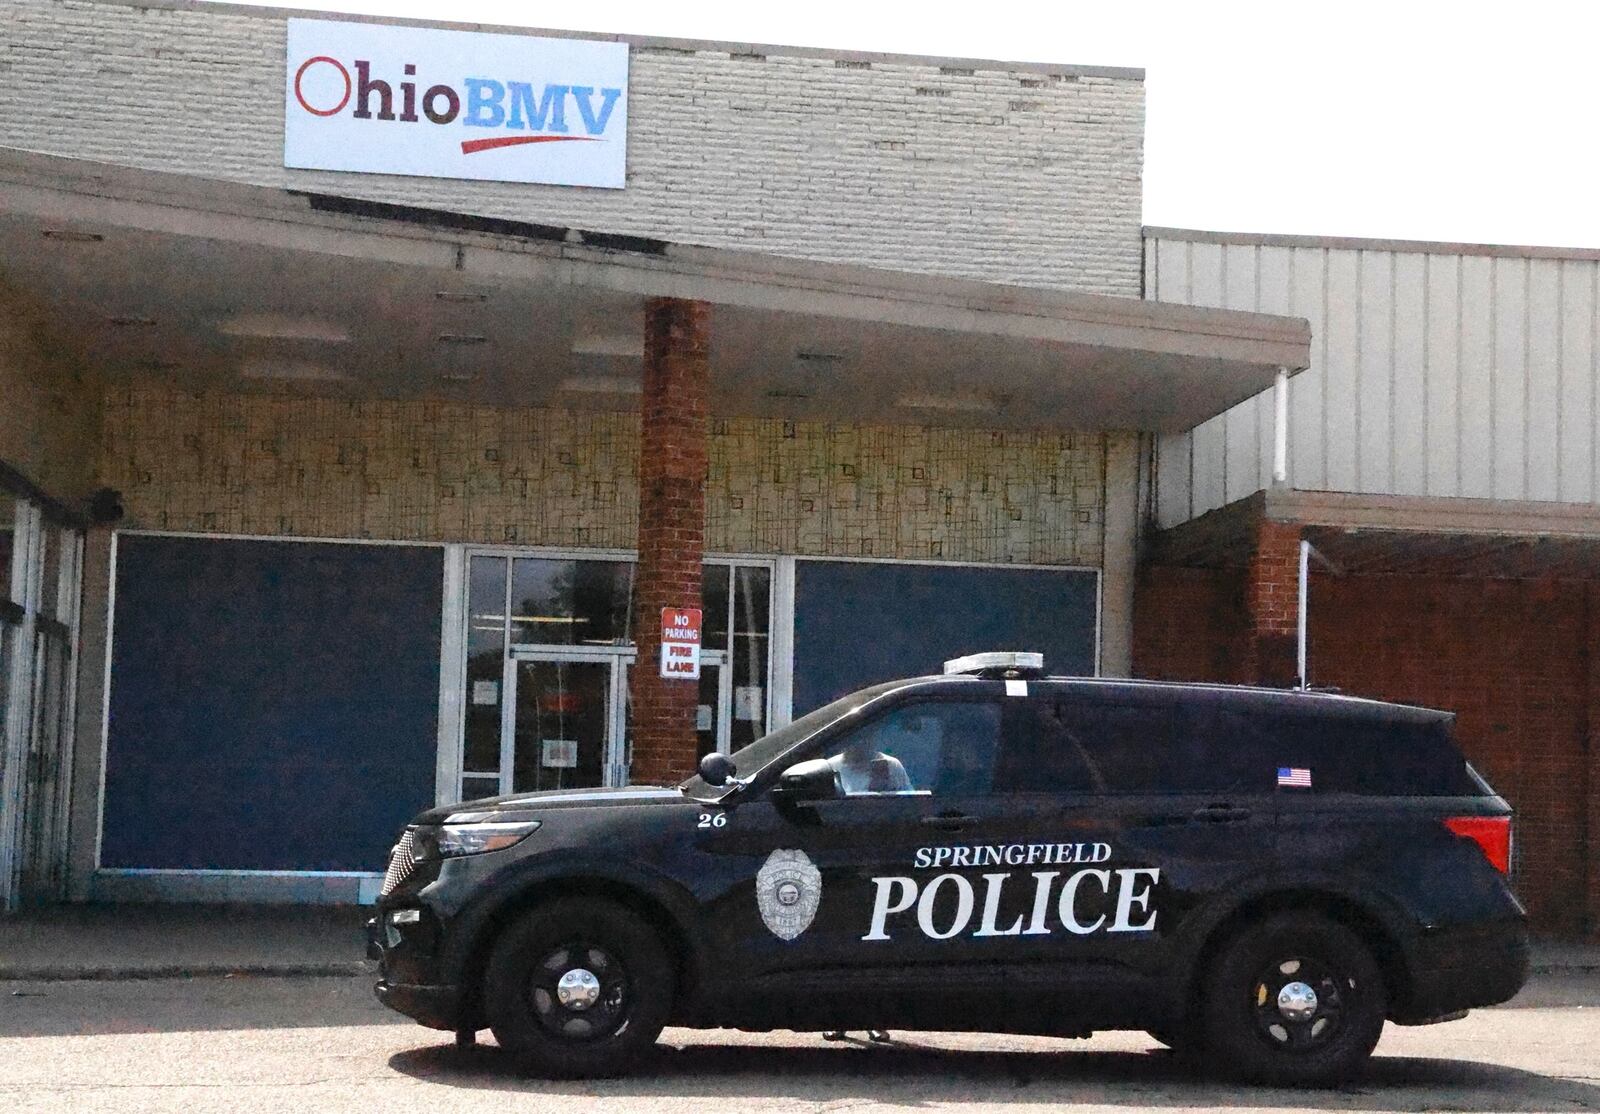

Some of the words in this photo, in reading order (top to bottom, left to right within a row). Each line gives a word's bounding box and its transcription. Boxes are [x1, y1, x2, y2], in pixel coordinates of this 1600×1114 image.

[674, 614, 689, 626] NO
[665, 628, 698, 640] PARKING
[670, 646, 692, 657] FIRE
[667, 662, 694, 673] LANE
[697, 812, 727, 828] 26
[914, 843, 1112, 868] SPRINGFIELD
[861, 868, 1160, 940] POLICE
